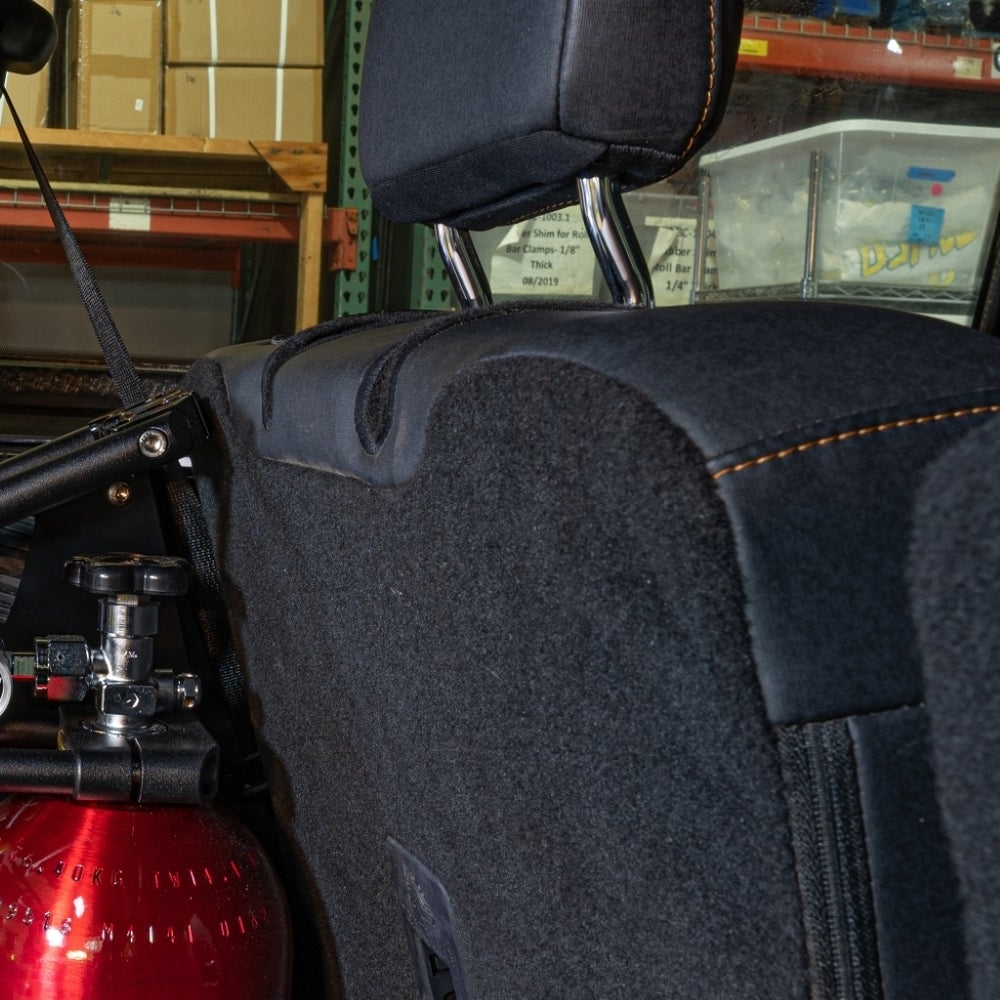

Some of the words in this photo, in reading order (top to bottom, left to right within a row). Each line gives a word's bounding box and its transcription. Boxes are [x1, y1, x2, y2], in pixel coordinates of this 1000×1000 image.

[533, 229, 555, 239] Shim
[556, 229, 570, 239] for
[505, 244, 520, 254] Bar
[530, 260, 553, 270] Thick
[675, 264, 691, 274] Bar
[521, 276, 559, 287] 08/2019
